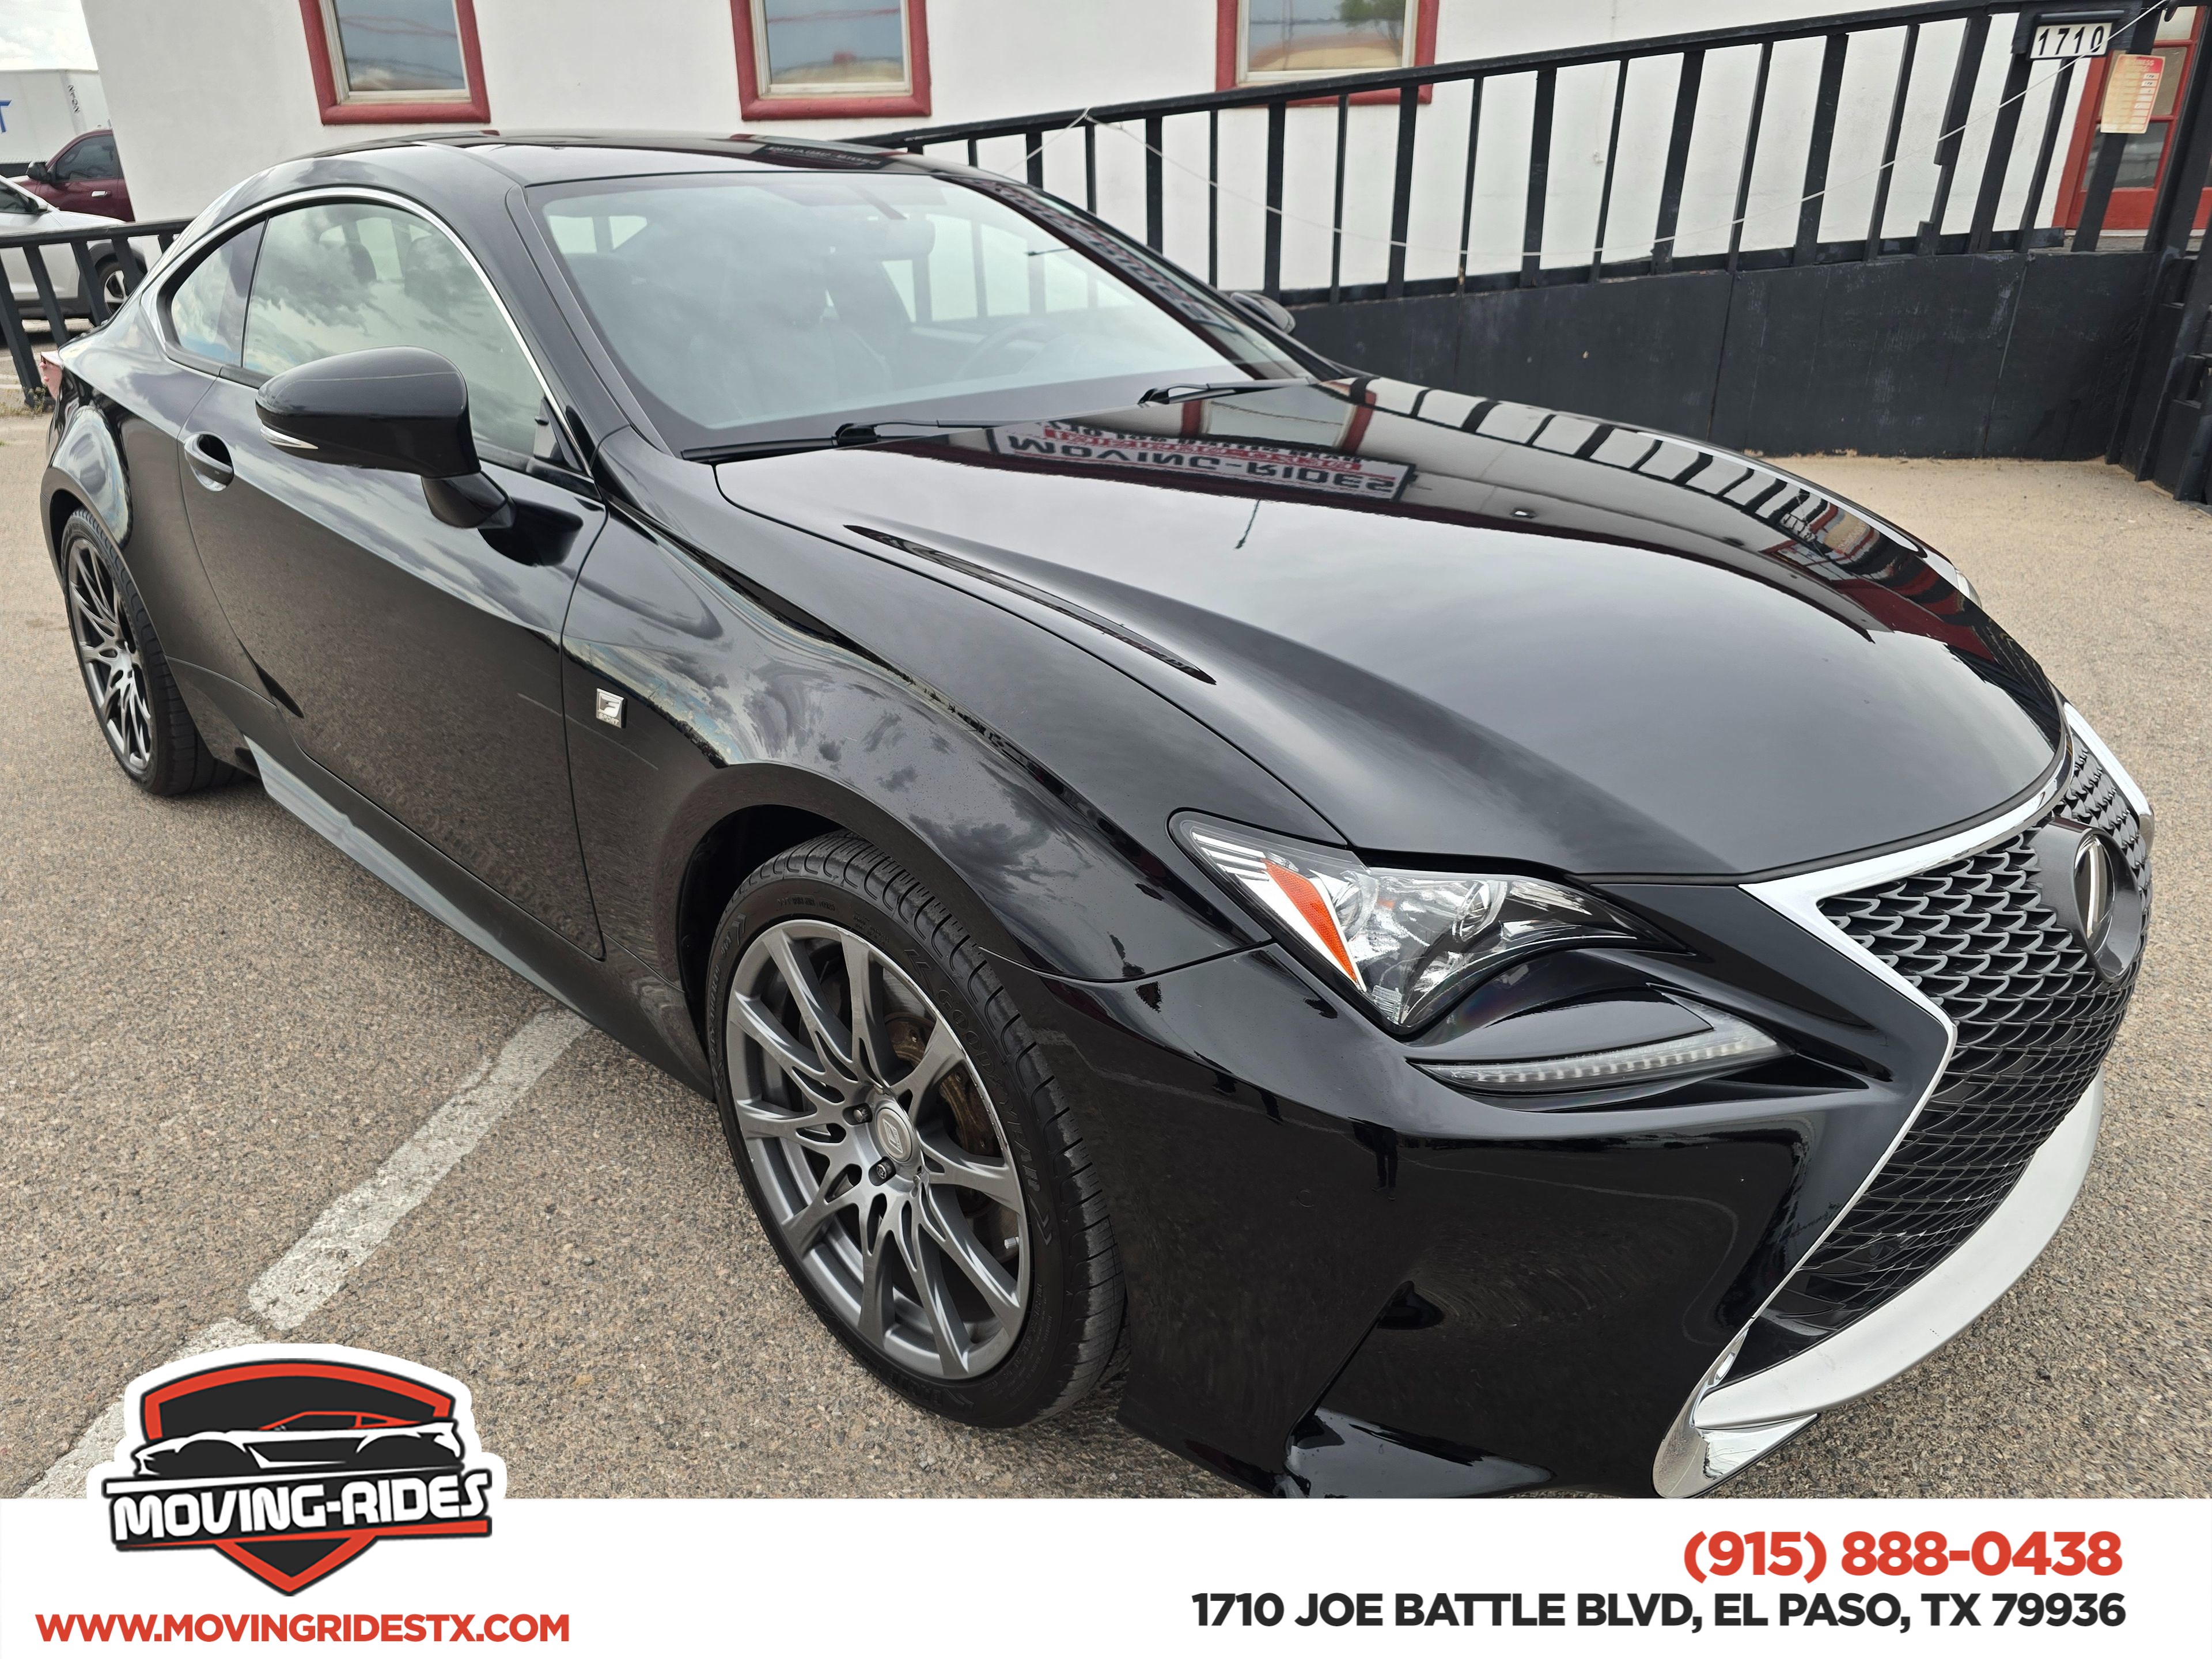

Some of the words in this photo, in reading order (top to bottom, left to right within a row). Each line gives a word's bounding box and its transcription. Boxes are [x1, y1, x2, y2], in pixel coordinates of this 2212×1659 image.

[2039, 25, 2105, 56] 1710
[67, 85, 80, 114] 2102
[599, 713, 619, 725] SPORT
